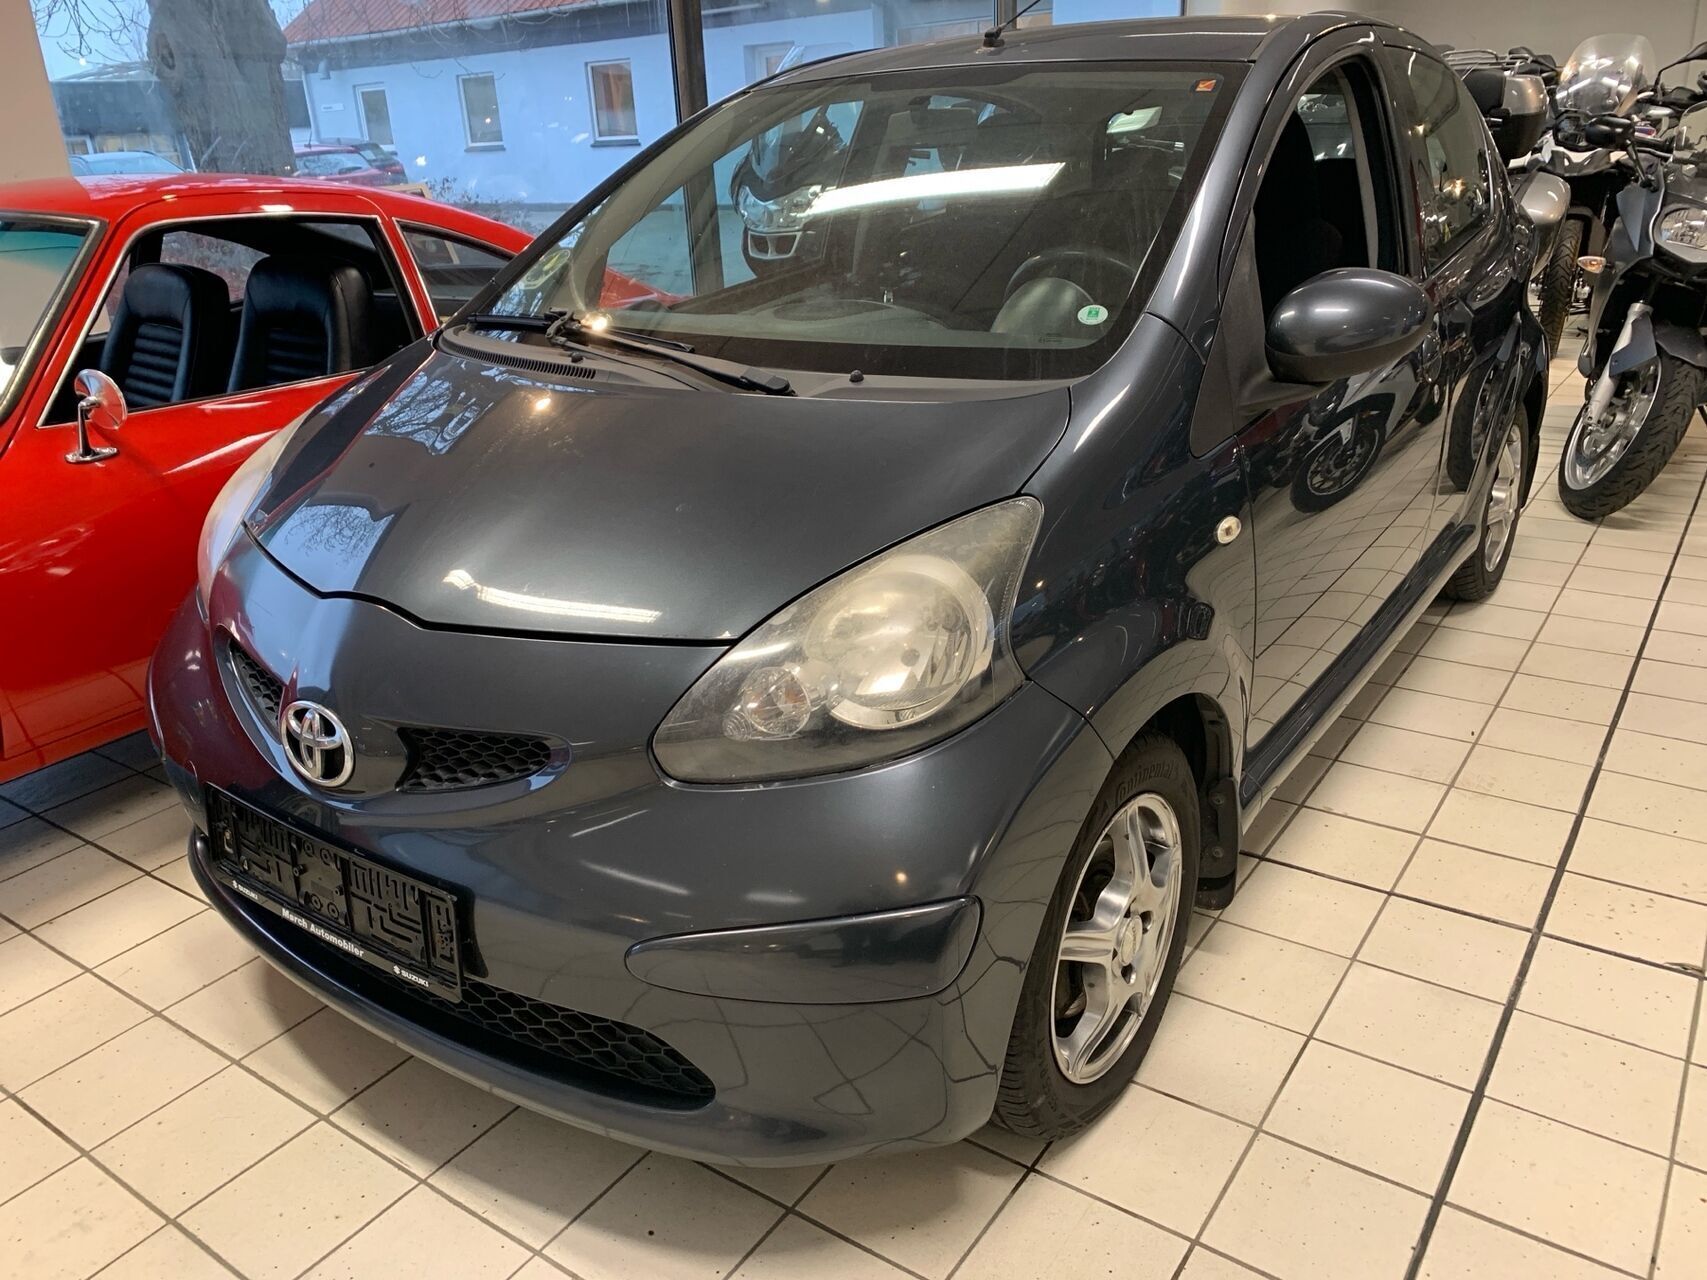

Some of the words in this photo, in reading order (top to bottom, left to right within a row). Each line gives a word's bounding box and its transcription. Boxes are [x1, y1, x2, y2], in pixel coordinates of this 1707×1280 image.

[1116, 761, 1174, 806] Continental
[310, 924, 365, 957] Automobiler
[401, 970, 429, 987] SUZUKI
